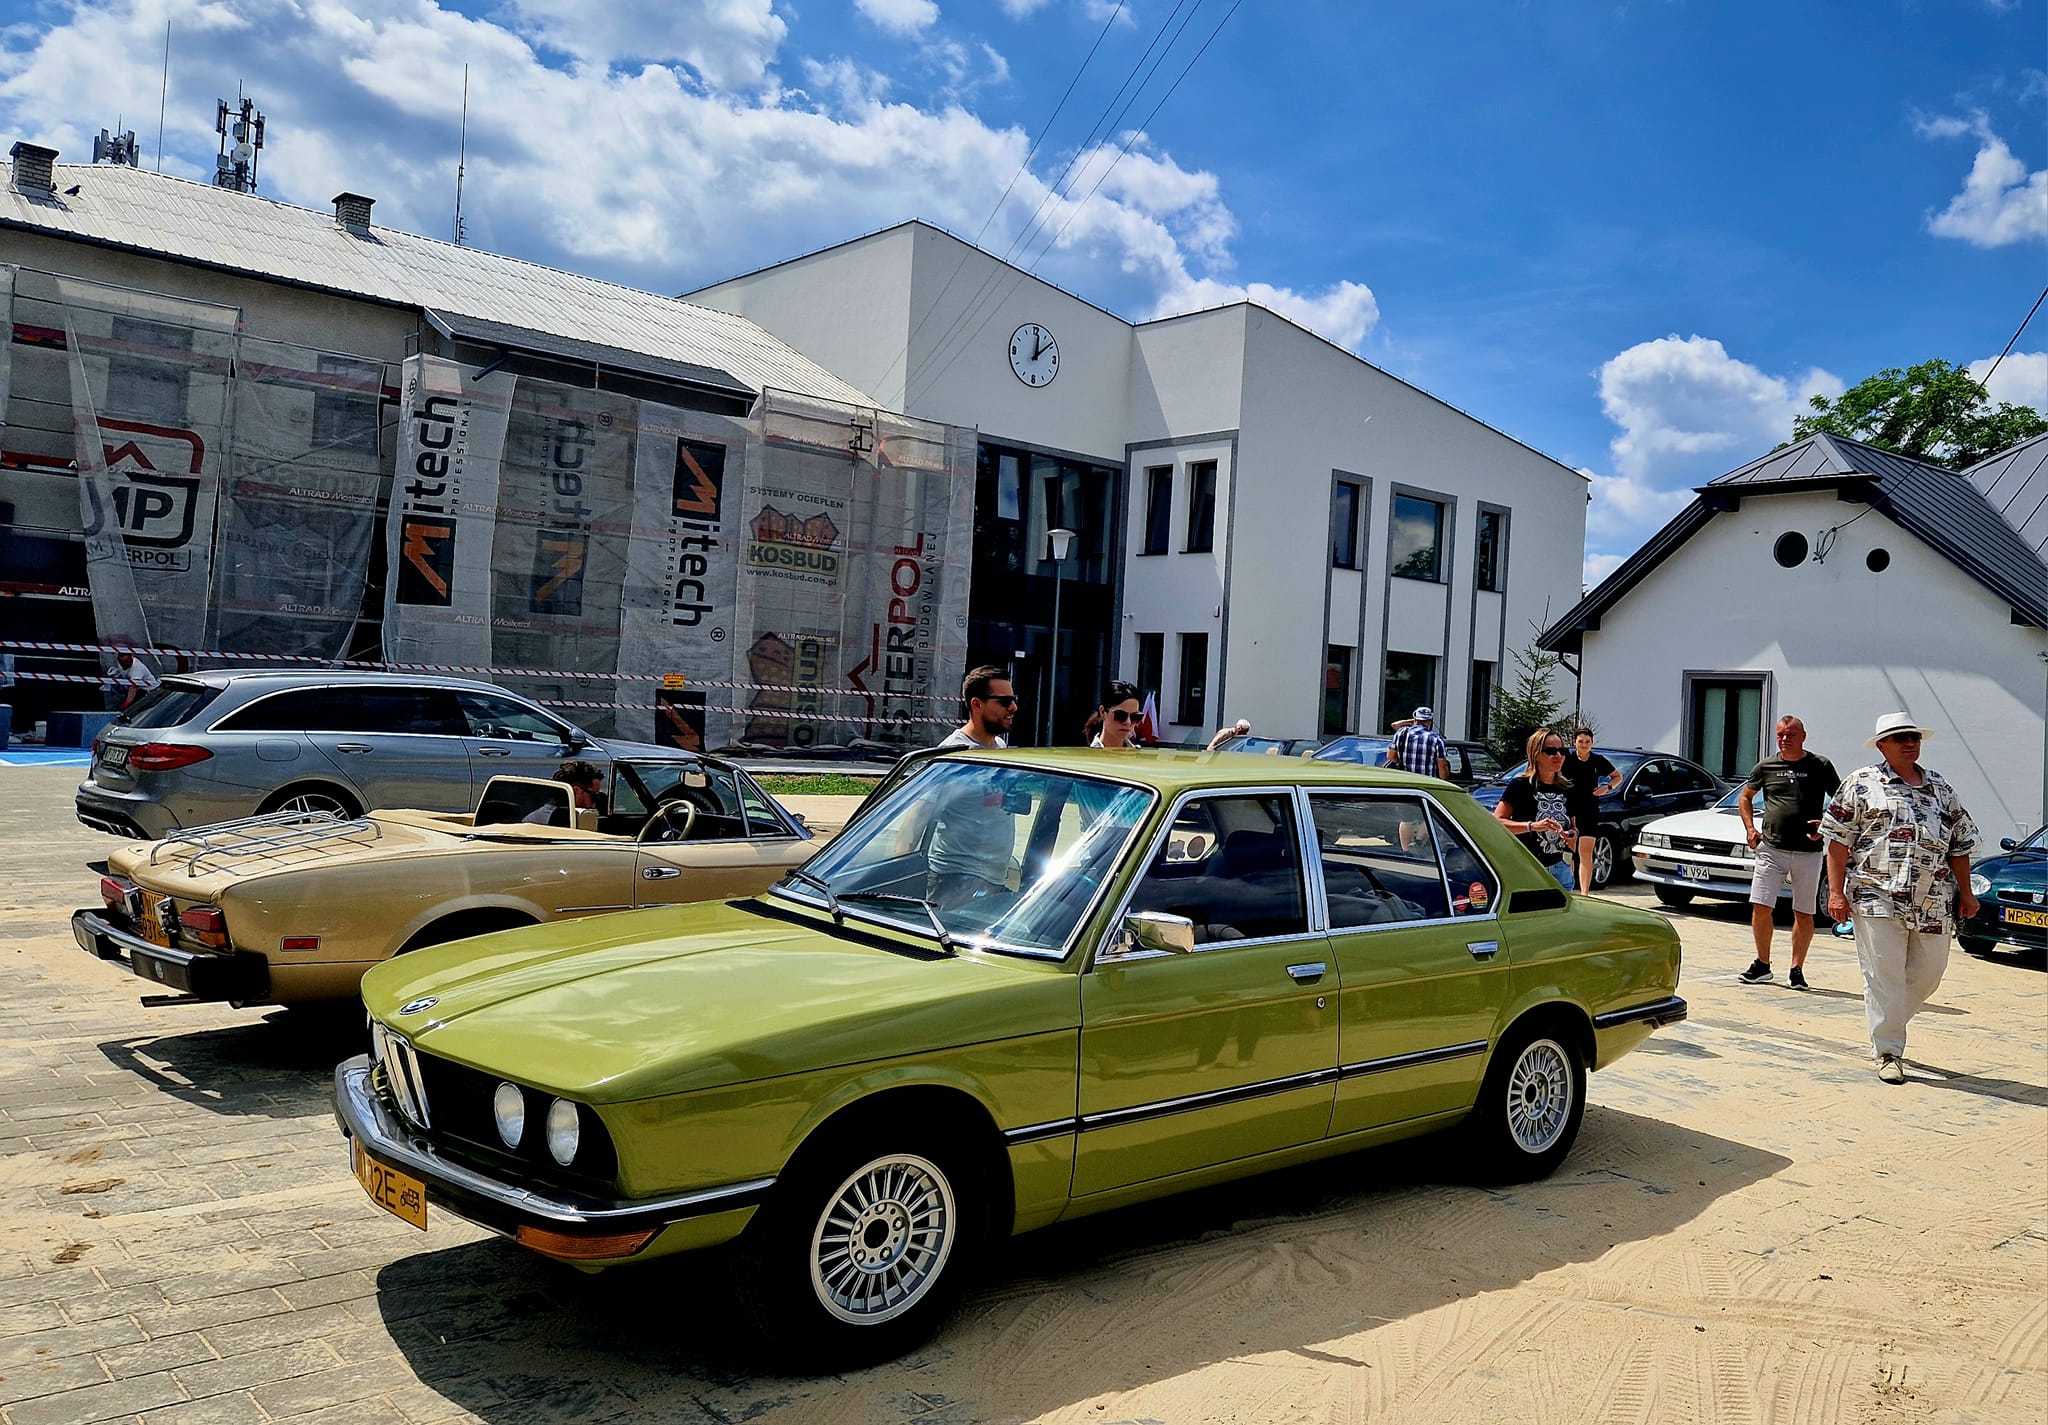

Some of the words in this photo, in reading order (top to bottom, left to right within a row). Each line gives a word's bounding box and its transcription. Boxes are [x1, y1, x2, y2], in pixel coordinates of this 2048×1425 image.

[1032, 326, 1040, 337] 12
[1011, 345, 1017, 355] 9
[1052, 355, 1057, 365] 3
[1031, 374, 1036, 384] 6
[449, 399, 472, 516] PROFESSIONAL
[288, 487, 330, 499] ALTRAD
[749, 486, 794, 499] SYSTEMY
[750, 545, 837, 572] KOSBUD
[918, 533, 937, 648] BUDOWLANEJ
[2007, 910, 2031, 923] WPS
